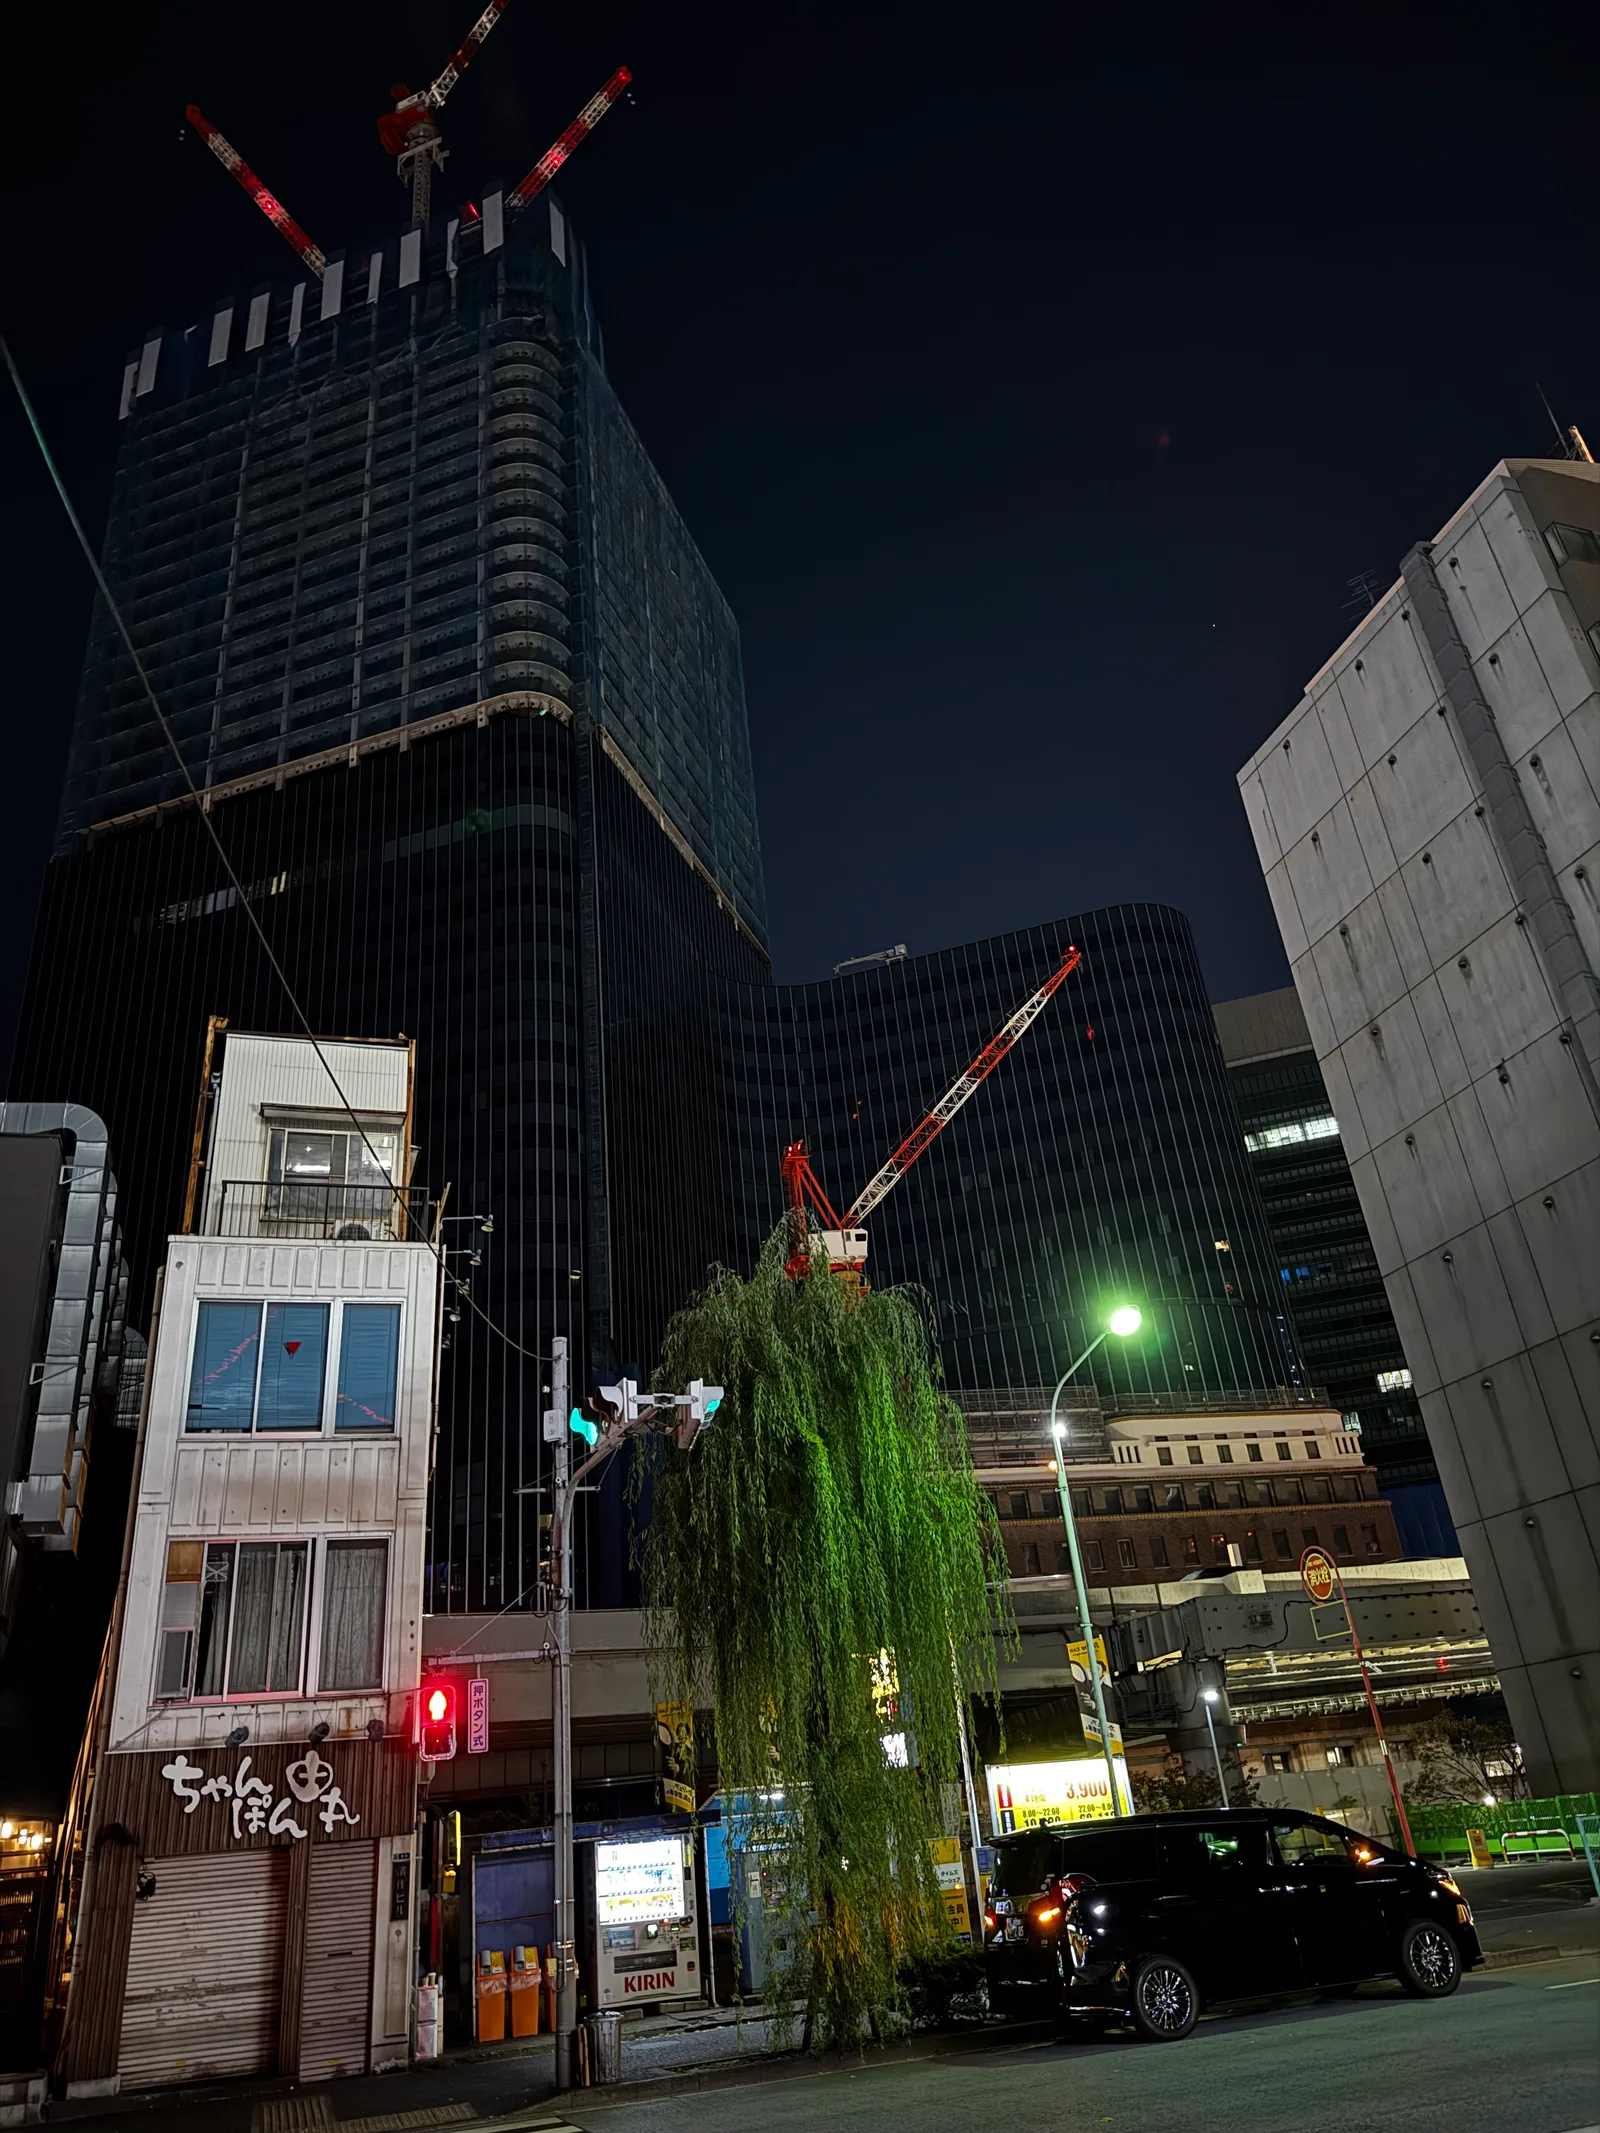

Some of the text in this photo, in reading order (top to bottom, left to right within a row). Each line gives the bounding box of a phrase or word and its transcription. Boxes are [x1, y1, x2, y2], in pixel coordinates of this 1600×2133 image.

[1307, 1566, 1330, 1587] 消火栓
[473, 1685, 484, 1747] 押ボタン式
[162, 1755, 273, 1814] ちゃん
[1066, 1780, 1108, 1800] 3,900
[232, 1794, 308, 1839] ぽん
[941, 1869, 958, 1877] タイムズ
[948, 1904, 964, 1914] 会員
[624, 1971, 675, 1994] KIRIN
